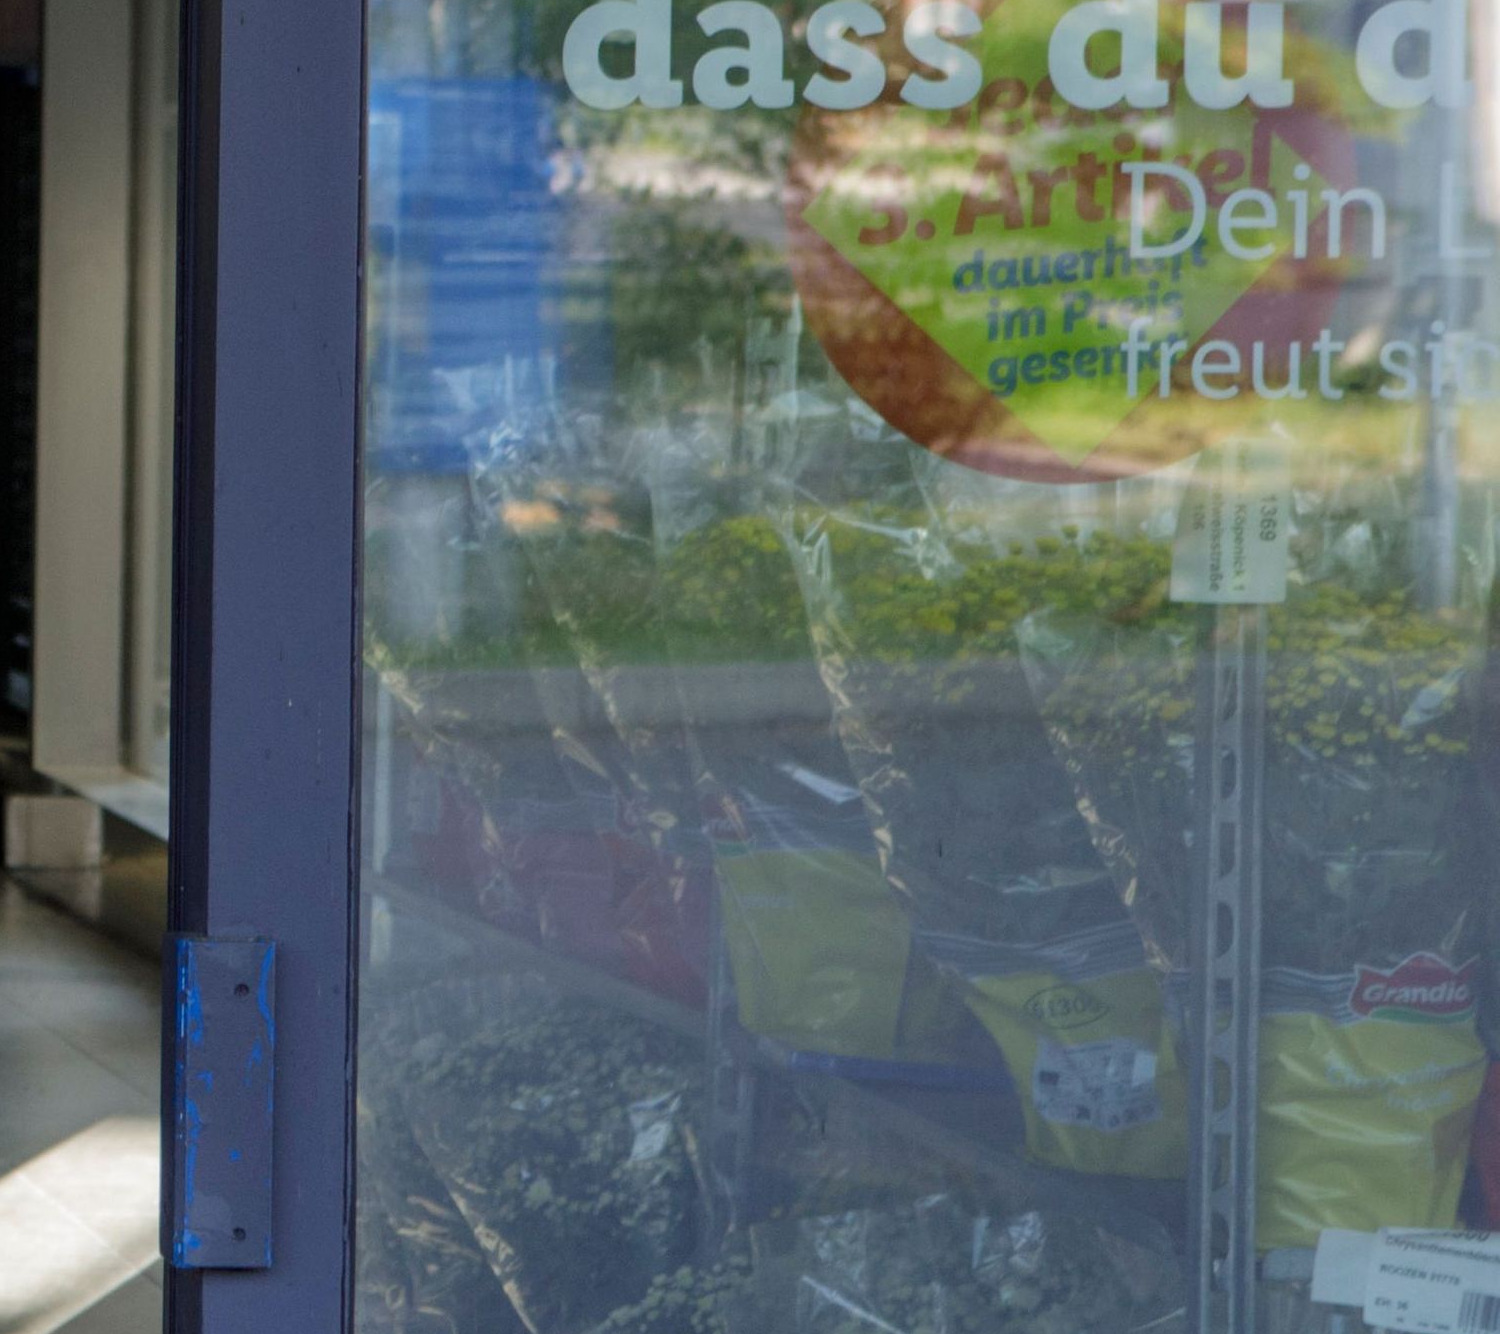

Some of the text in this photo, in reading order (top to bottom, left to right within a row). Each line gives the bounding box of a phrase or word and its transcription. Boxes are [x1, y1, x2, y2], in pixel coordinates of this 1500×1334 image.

[1122, 162, 1386, 262] Dein
[986, 297, 1047, 342] im
[1122, 318, 1344, 401] freut
